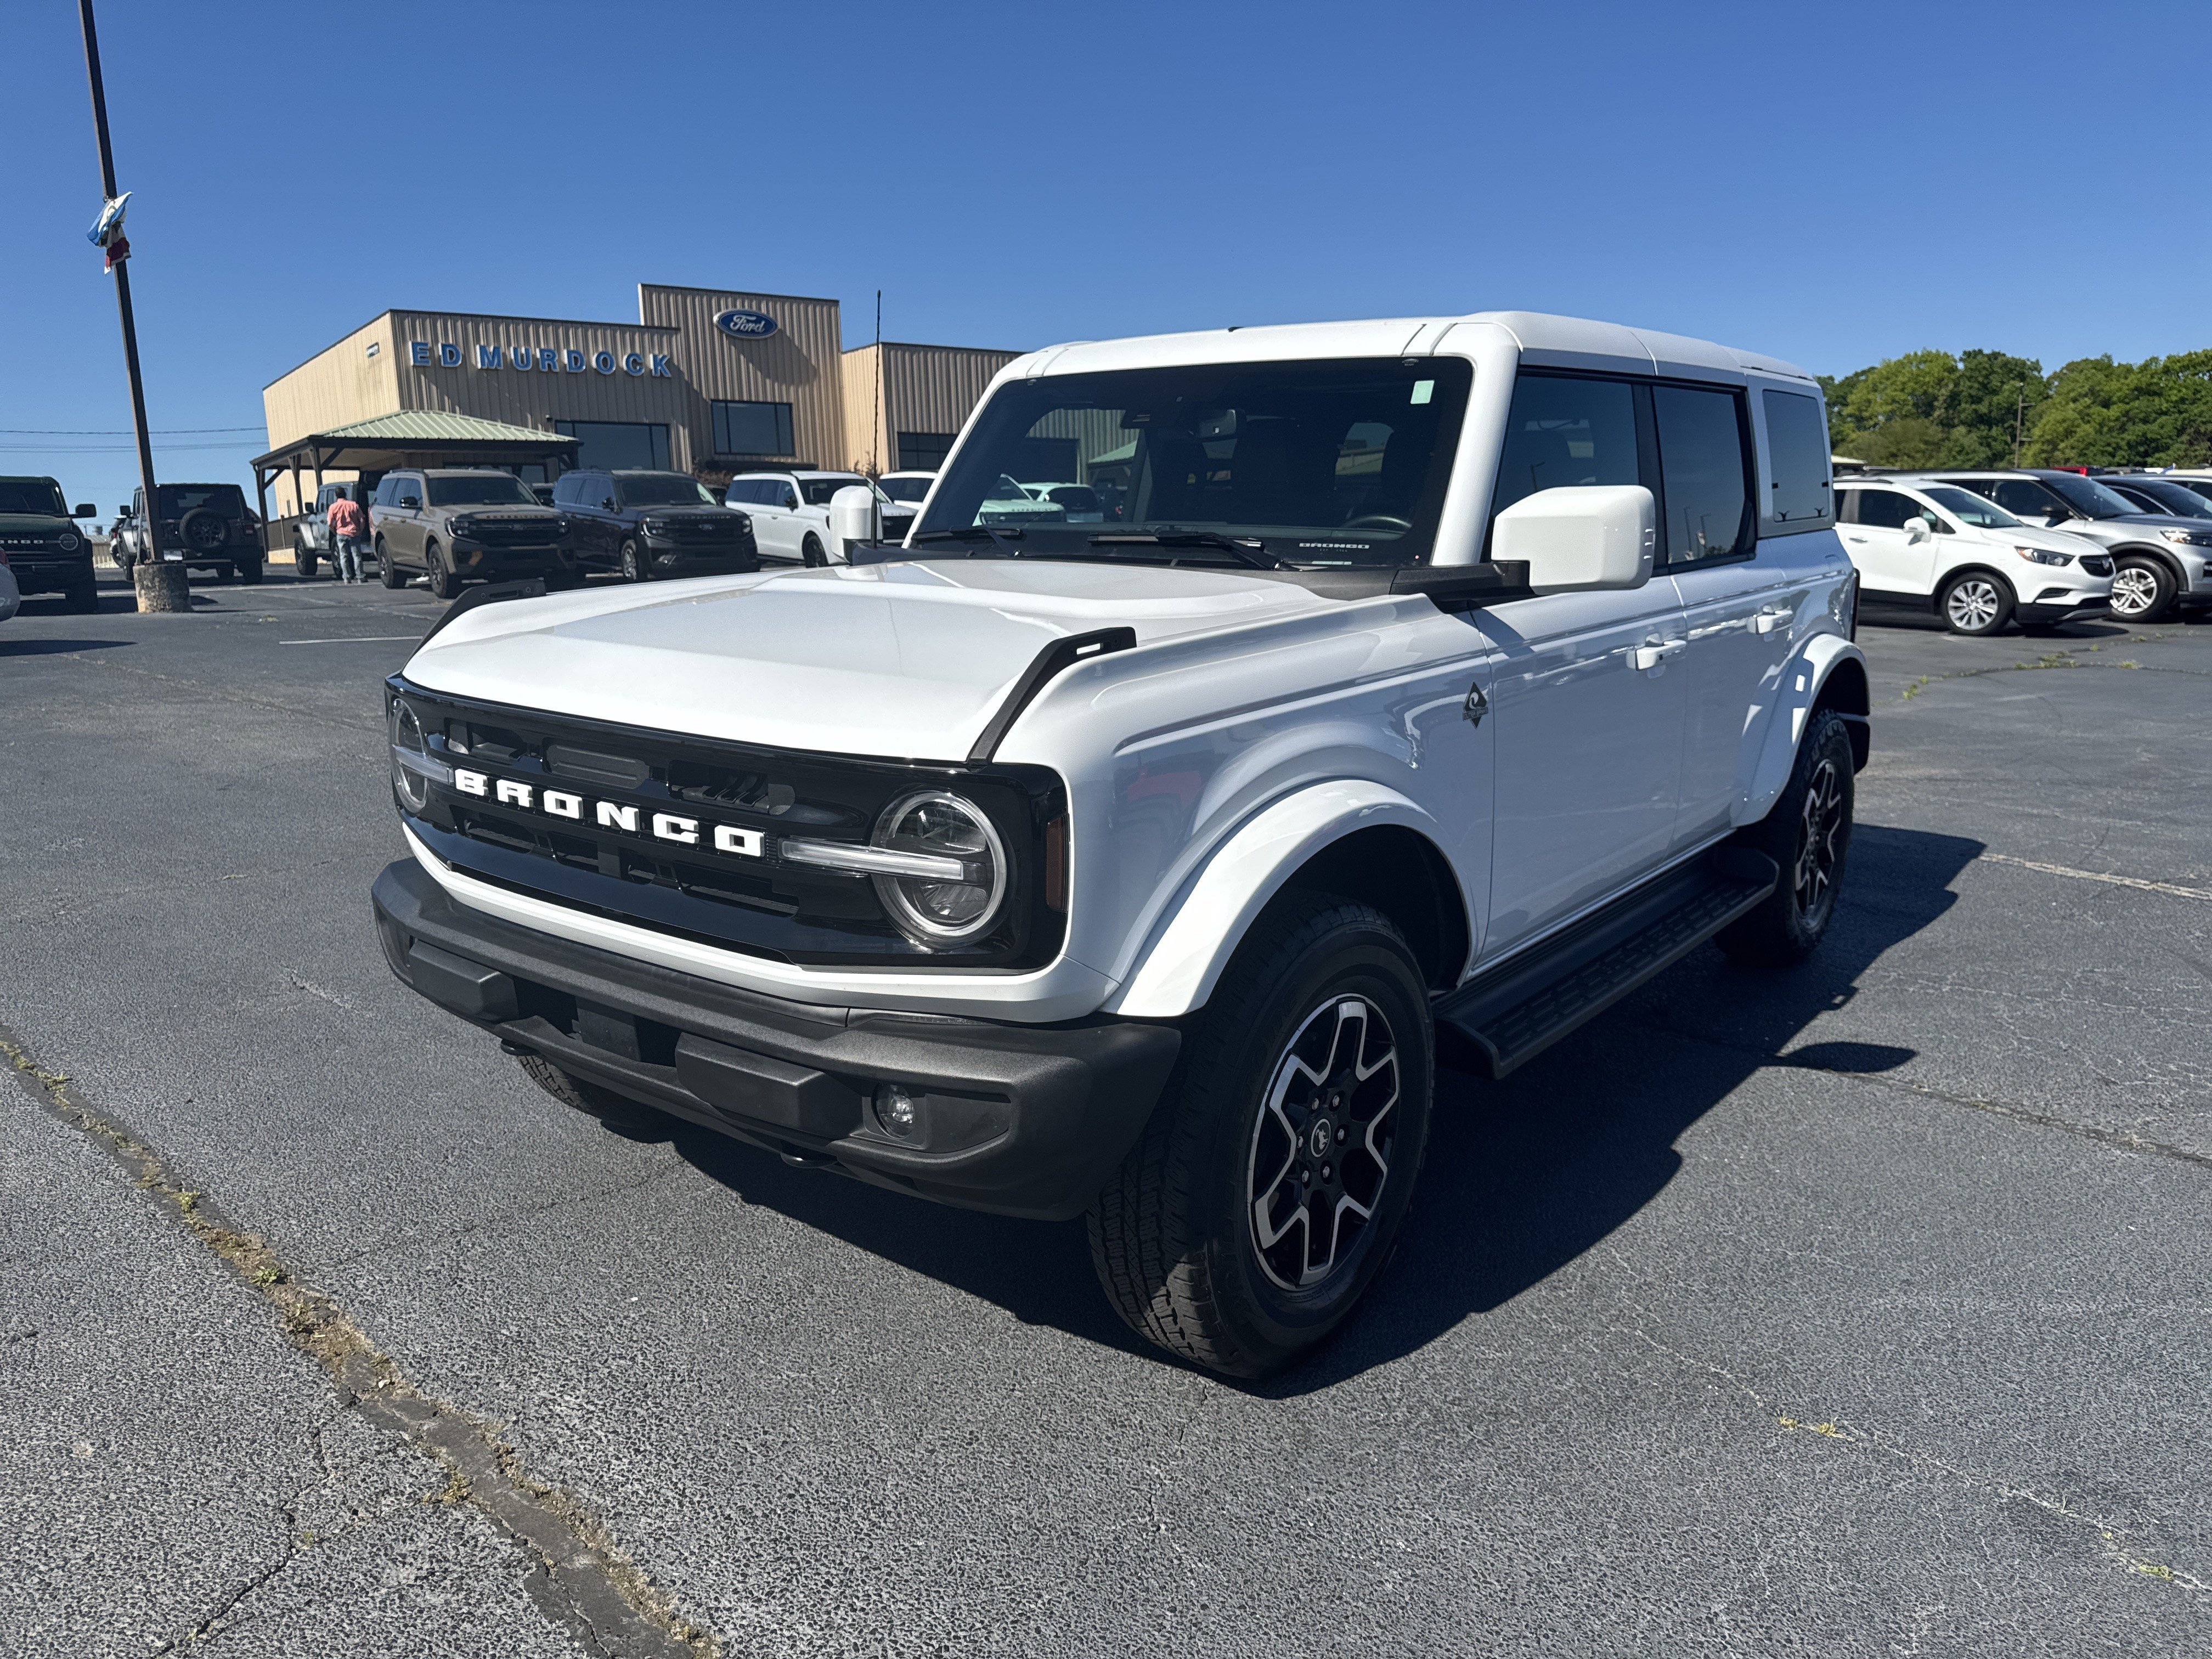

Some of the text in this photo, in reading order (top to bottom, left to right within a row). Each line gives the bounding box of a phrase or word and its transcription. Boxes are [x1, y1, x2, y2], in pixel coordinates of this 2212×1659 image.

[730, 314, 765, 332] Ford
[409, 340, 672, 377] ED MURDOCK
[455, 768, 765, 857] BRONCO
